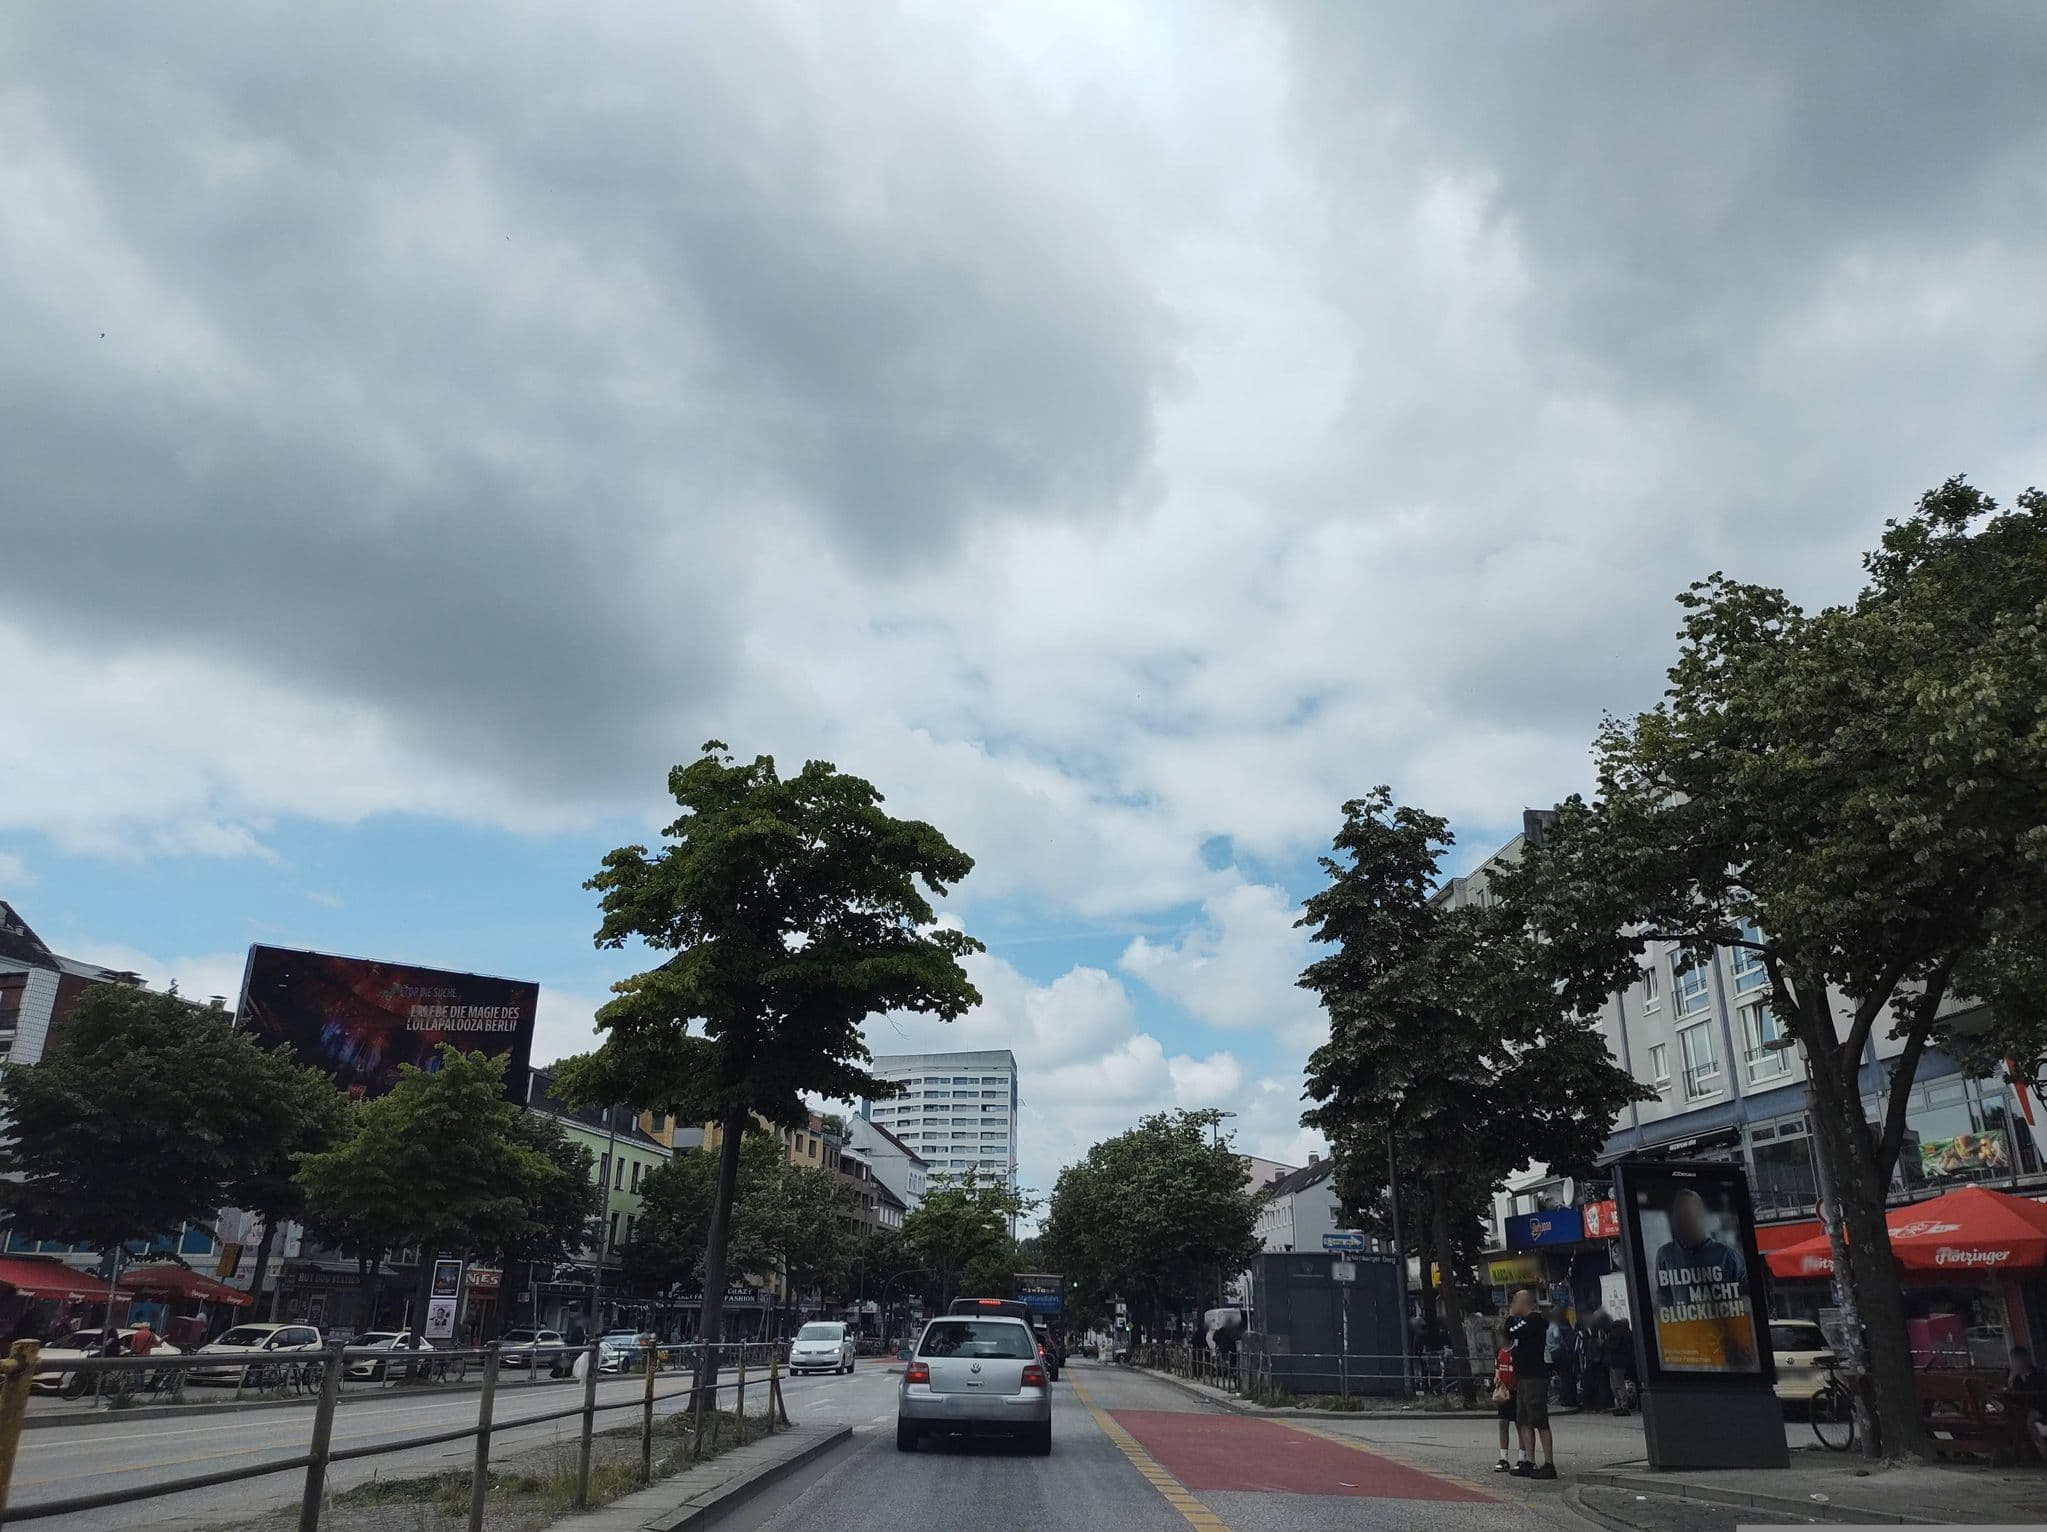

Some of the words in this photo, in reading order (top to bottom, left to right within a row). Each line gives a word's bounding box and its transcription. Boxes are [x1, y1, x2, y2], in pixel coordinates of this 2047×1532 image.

[406, 1016, 483, 1031] LOLLAPALOOZA
[450, 1005, 468, 1018] DIE
[468, 1006, 500, 1019] MAGIE
[501, 1006, 520, 1020] DES
[1658, 1265, 1723, 1287] BILDUNG
[1688, 1281, 1740, 1303] MACHT
[1658, 1299, 1745, 1324] GLÜCKLICH!
